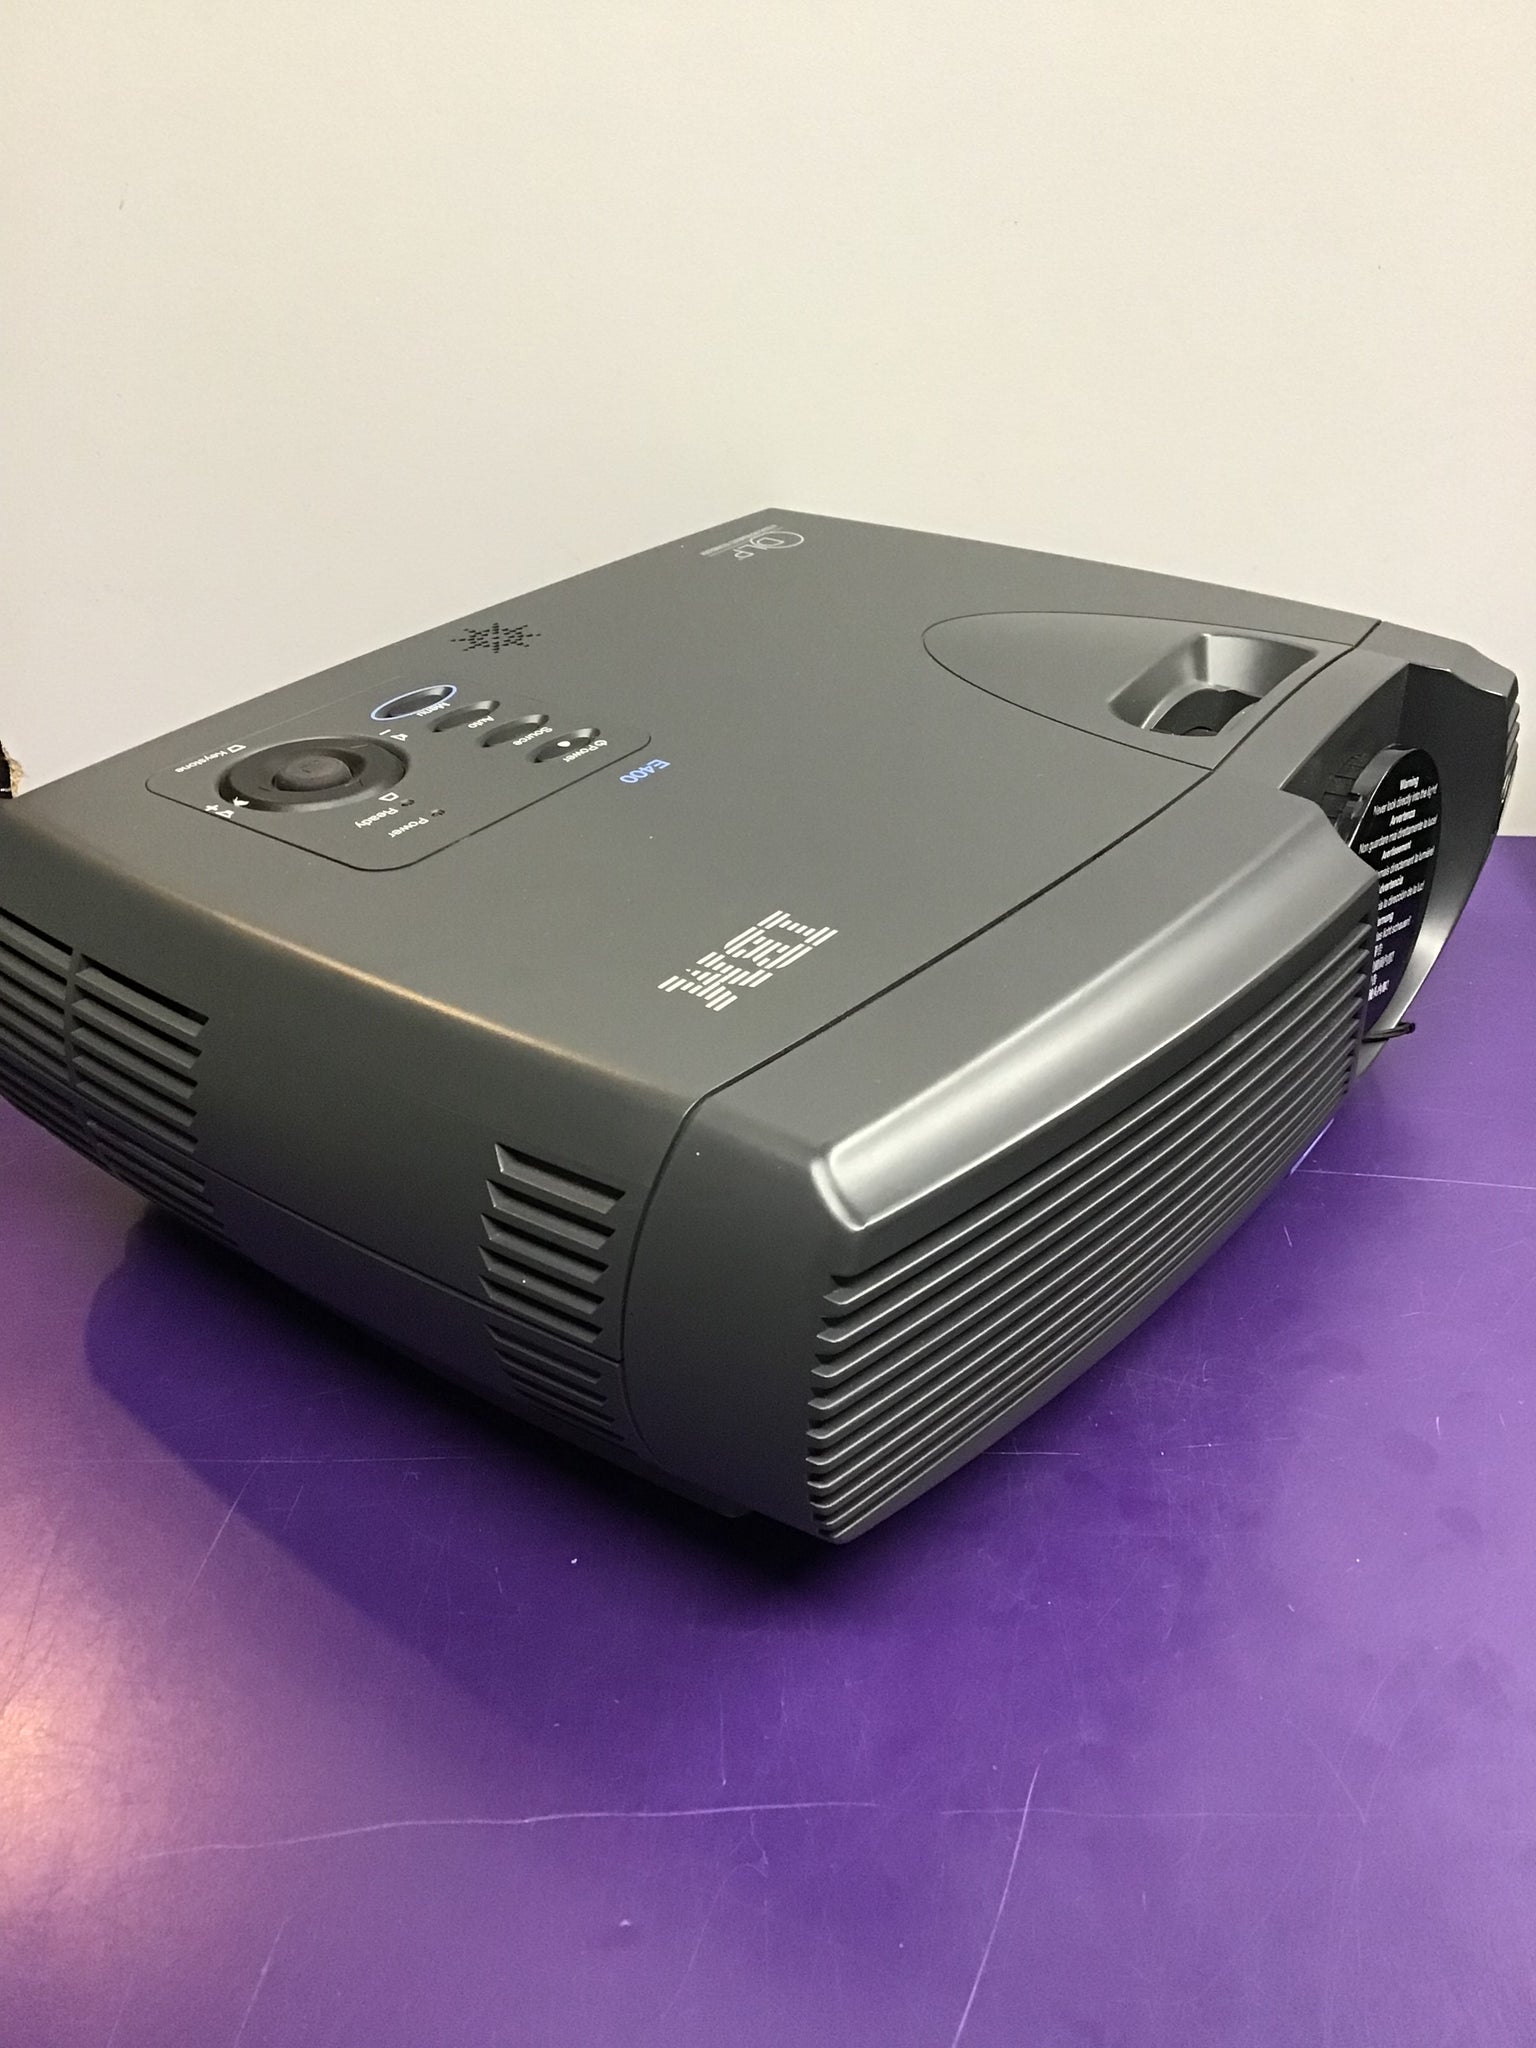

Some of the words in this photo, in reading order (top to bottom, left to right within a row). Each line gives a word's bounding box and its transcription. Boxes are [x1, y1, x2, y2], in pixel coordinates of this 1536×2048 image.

[416, 702, 451, 717] Menu
[468, 715, 495, 729] Auto
[512, 726, 553, 746] Source
[175, 750, 229, 773] Keystone
[562, 742, 600, 763] Power
[619, 758, 671, 784] E400
[1386, 798, 1397, 812] look
[1396, 793, 1412, 808] directly
[355, 807, 399, 828] Ready
[387, 817, 429, 838] Power
[657, 910, 839, 1012] IBM
